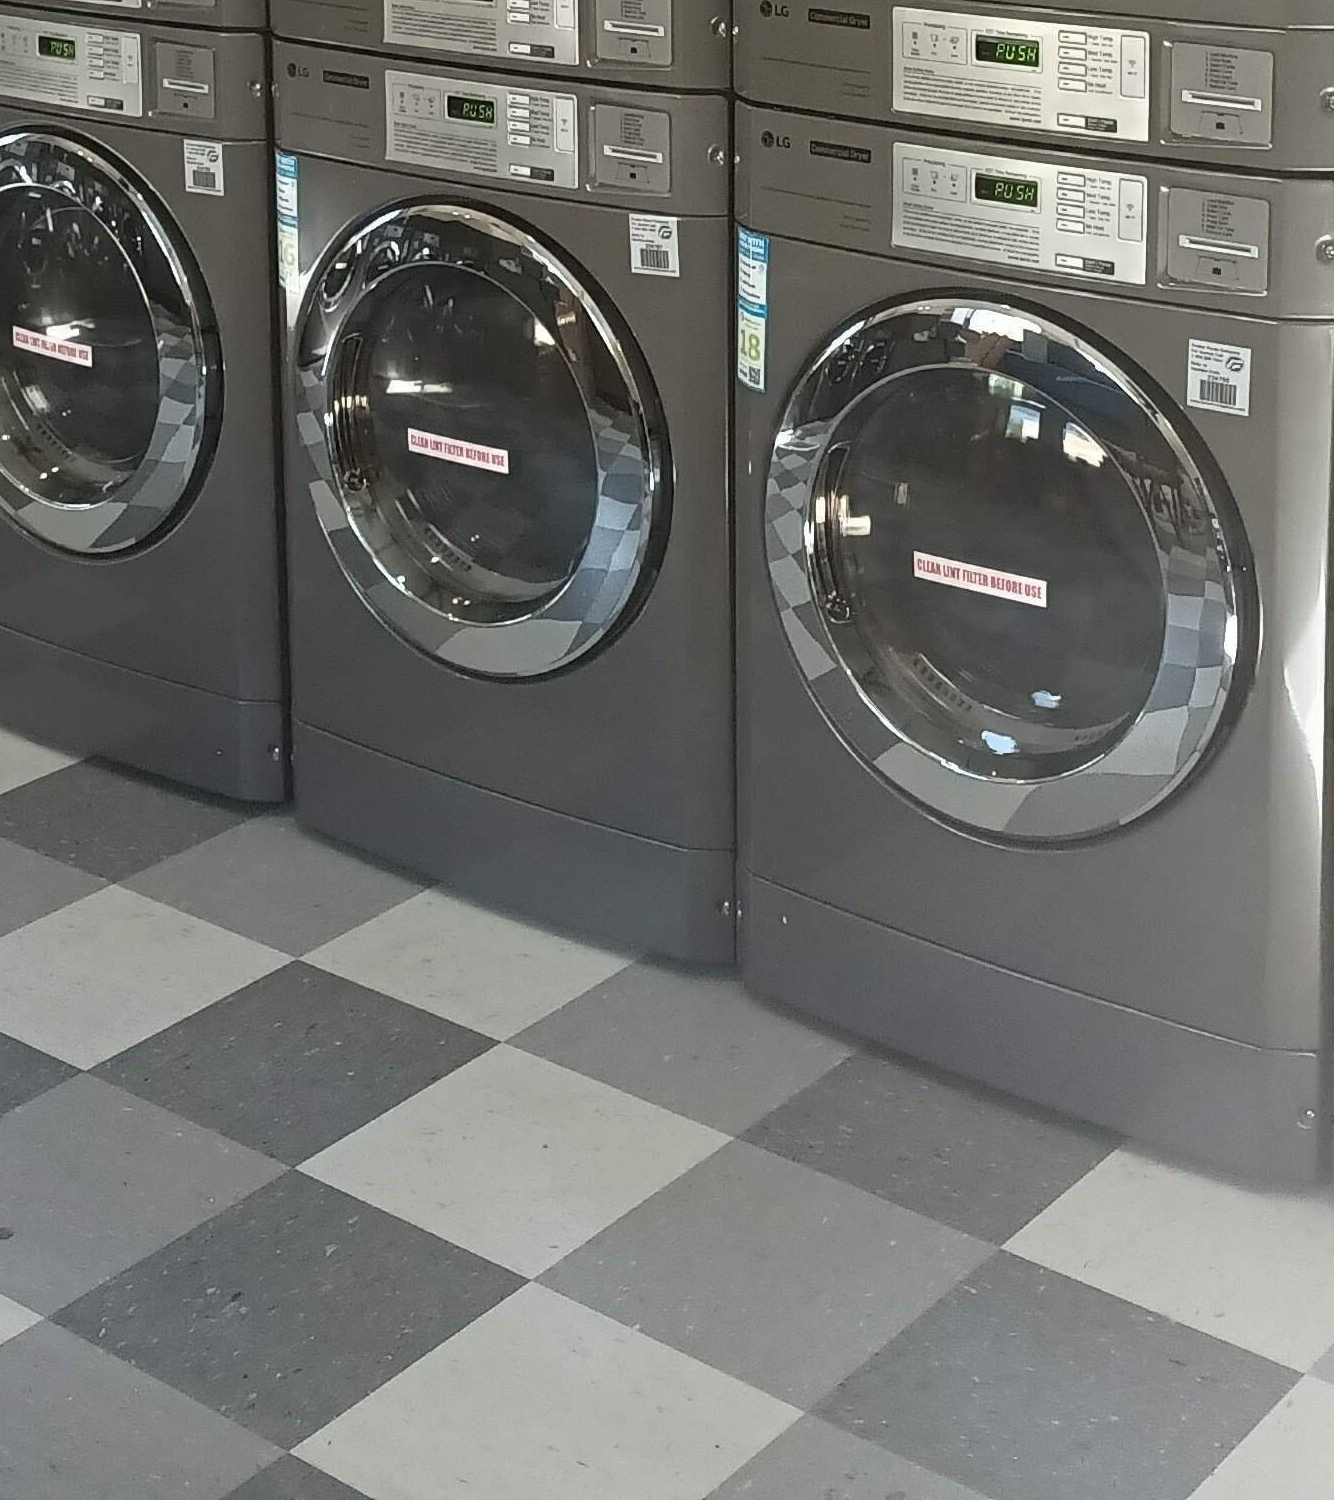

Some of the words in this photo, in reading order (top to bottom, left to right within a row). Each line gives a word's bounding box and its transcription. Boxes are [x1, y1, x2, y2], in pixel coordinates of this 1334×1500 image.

[774, 4, 789, 17] LG
[996, 44, 1036, 61] PUSH
[463, 103, 492, 119] PUSH
[777, 137, 790, 148] LG
[995, 183, 1034, 200] PUSH
[741, 330, 760, 361] 18
[411, 435, 428, 448] CLEAN
[430, 440, 442, 452] LINT
[444, 443, 463, 456] FILTER
[466, 447, 489, 463] BEFORE
[491, 454, 504, 467] USE
[917, 559, 941, 574] CLEAN
[943, 565, 959, 580] LINT
[963, 570, 988, 586] FILTER
[991, 576, 1023, 594] BEFORE
[1025, 585, 1042, 599] USE
